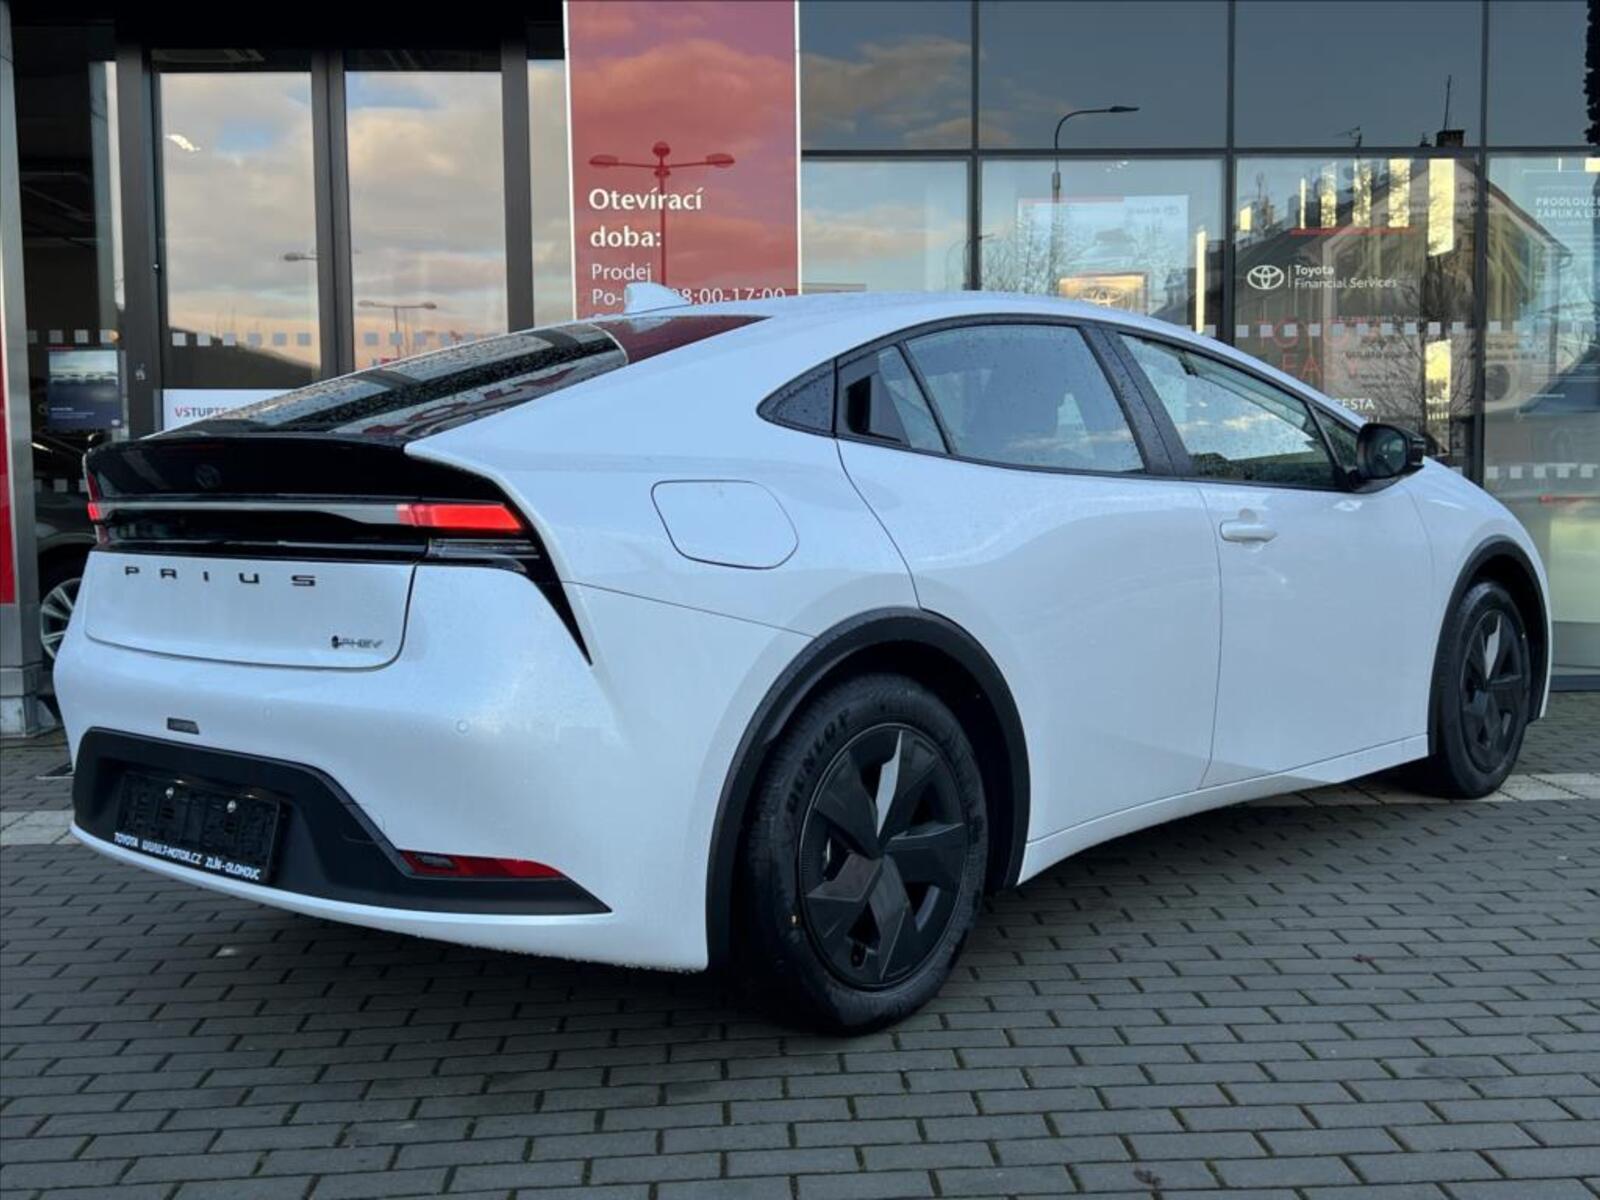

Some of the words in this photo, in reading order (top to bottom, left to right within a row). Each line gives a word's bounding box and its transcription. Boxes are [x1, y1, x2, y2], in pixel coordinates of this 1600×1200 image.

[588, 187, 703, 210] Otevírací
[590, 225, 661, 247] doba:
[592, 263, 651, 283] Prodej
[1294, 265, 1334, 277] Toyota
[1294, 277, 1347, 289] Financial
[1350, 277, 1397, 289] Services
[592, 288, 625, 305] Po-
[125, 566, 315, 587] PRIUS
